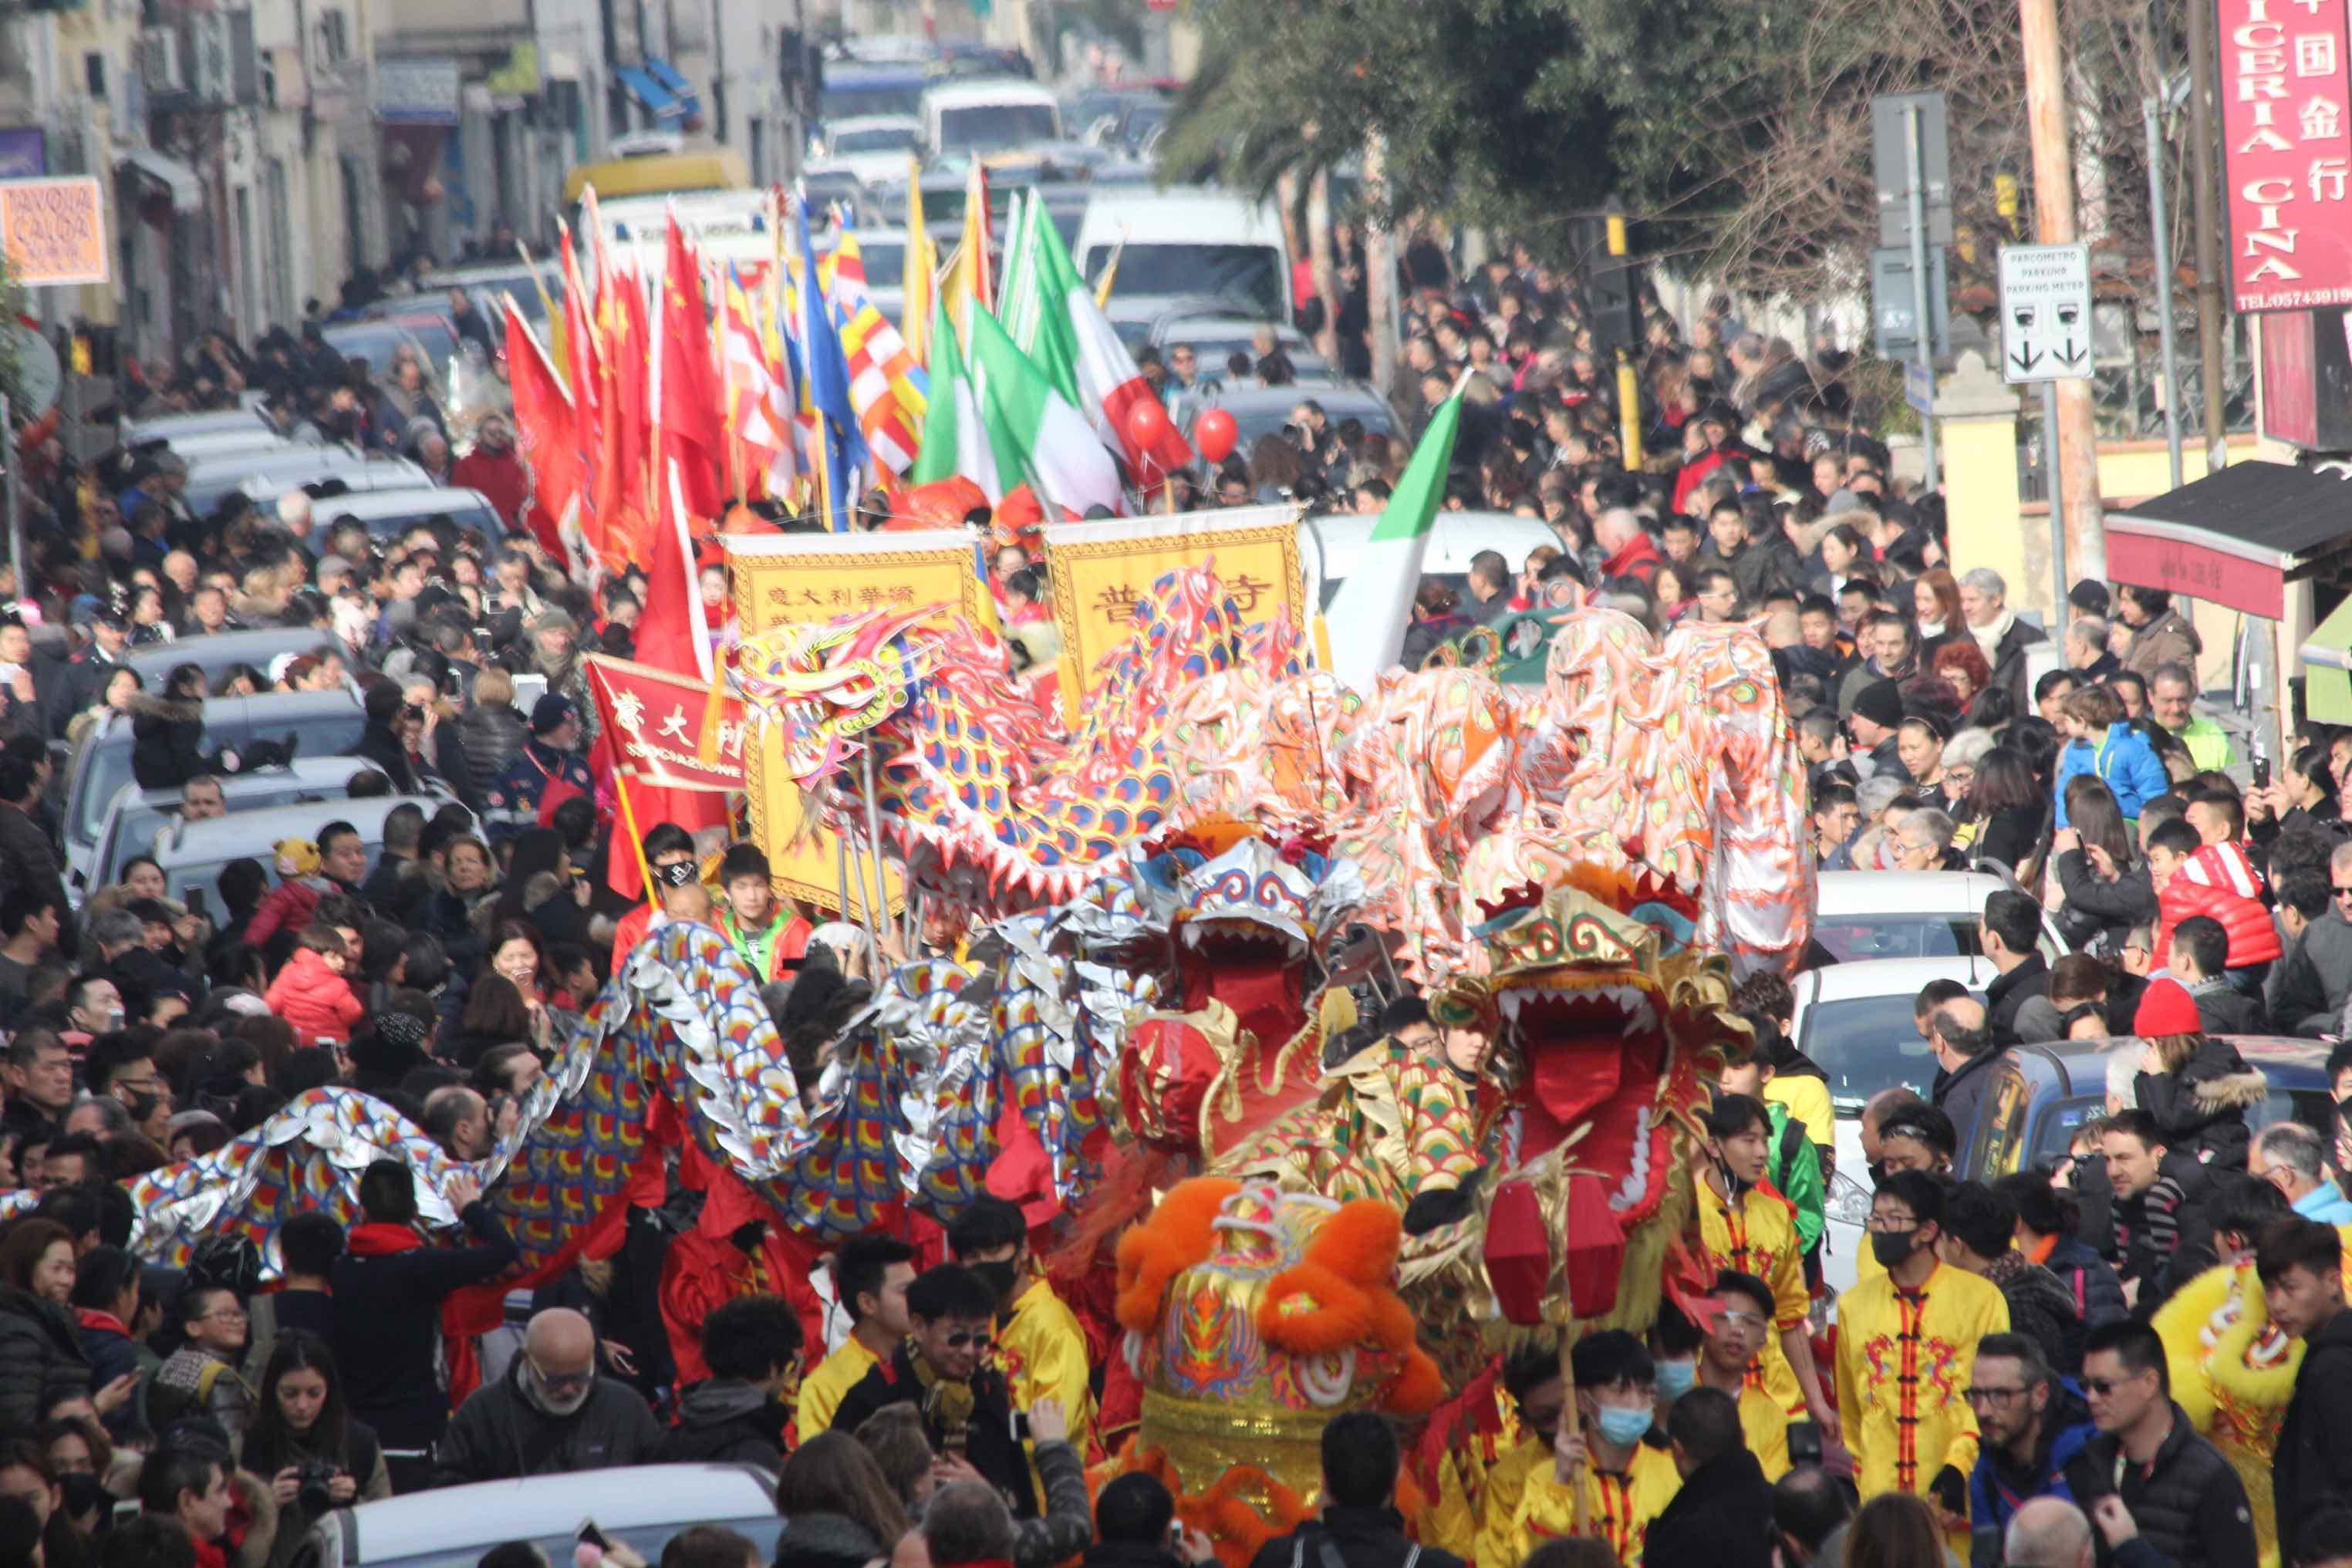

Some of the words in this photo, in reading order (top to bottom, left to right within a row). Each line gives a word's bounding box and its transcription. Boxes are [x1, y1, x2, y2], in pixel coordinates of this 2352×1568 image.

[2241, 177, 2302, 284] CINA
[2011, 251, 2077, 263] PARCOMETRO
[2006, 282, 2049, 295] PARKING
[2052, 280, 2084, 292] METER
[1092, 572, 1274, 624] 普寺
[626, 742, 741, 778] SSOCIAZIONE
